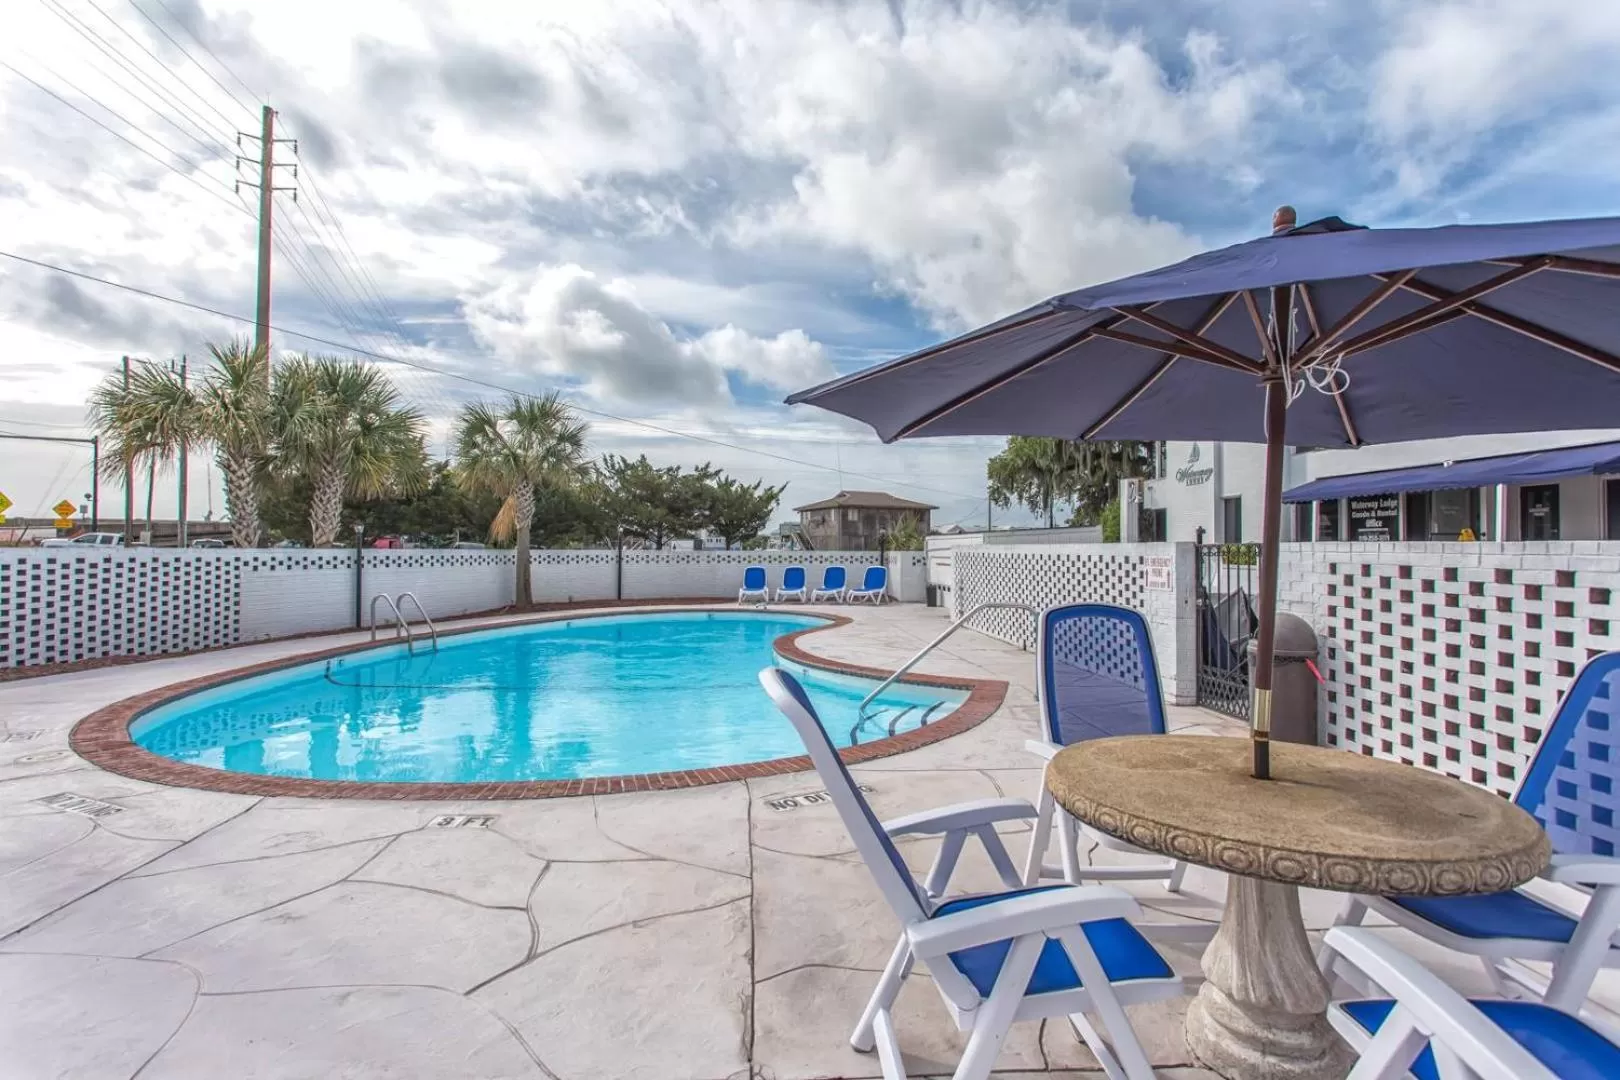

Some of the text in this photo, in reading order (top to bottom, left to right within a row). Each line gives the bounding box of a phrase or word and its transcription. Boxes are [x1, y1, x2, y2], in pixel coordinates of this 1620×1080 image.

[1352, 499, 1397, 509] Waterway Lodge
[1366, 519, 1383, 527] Office
[770, 799, 798, 811] NO
